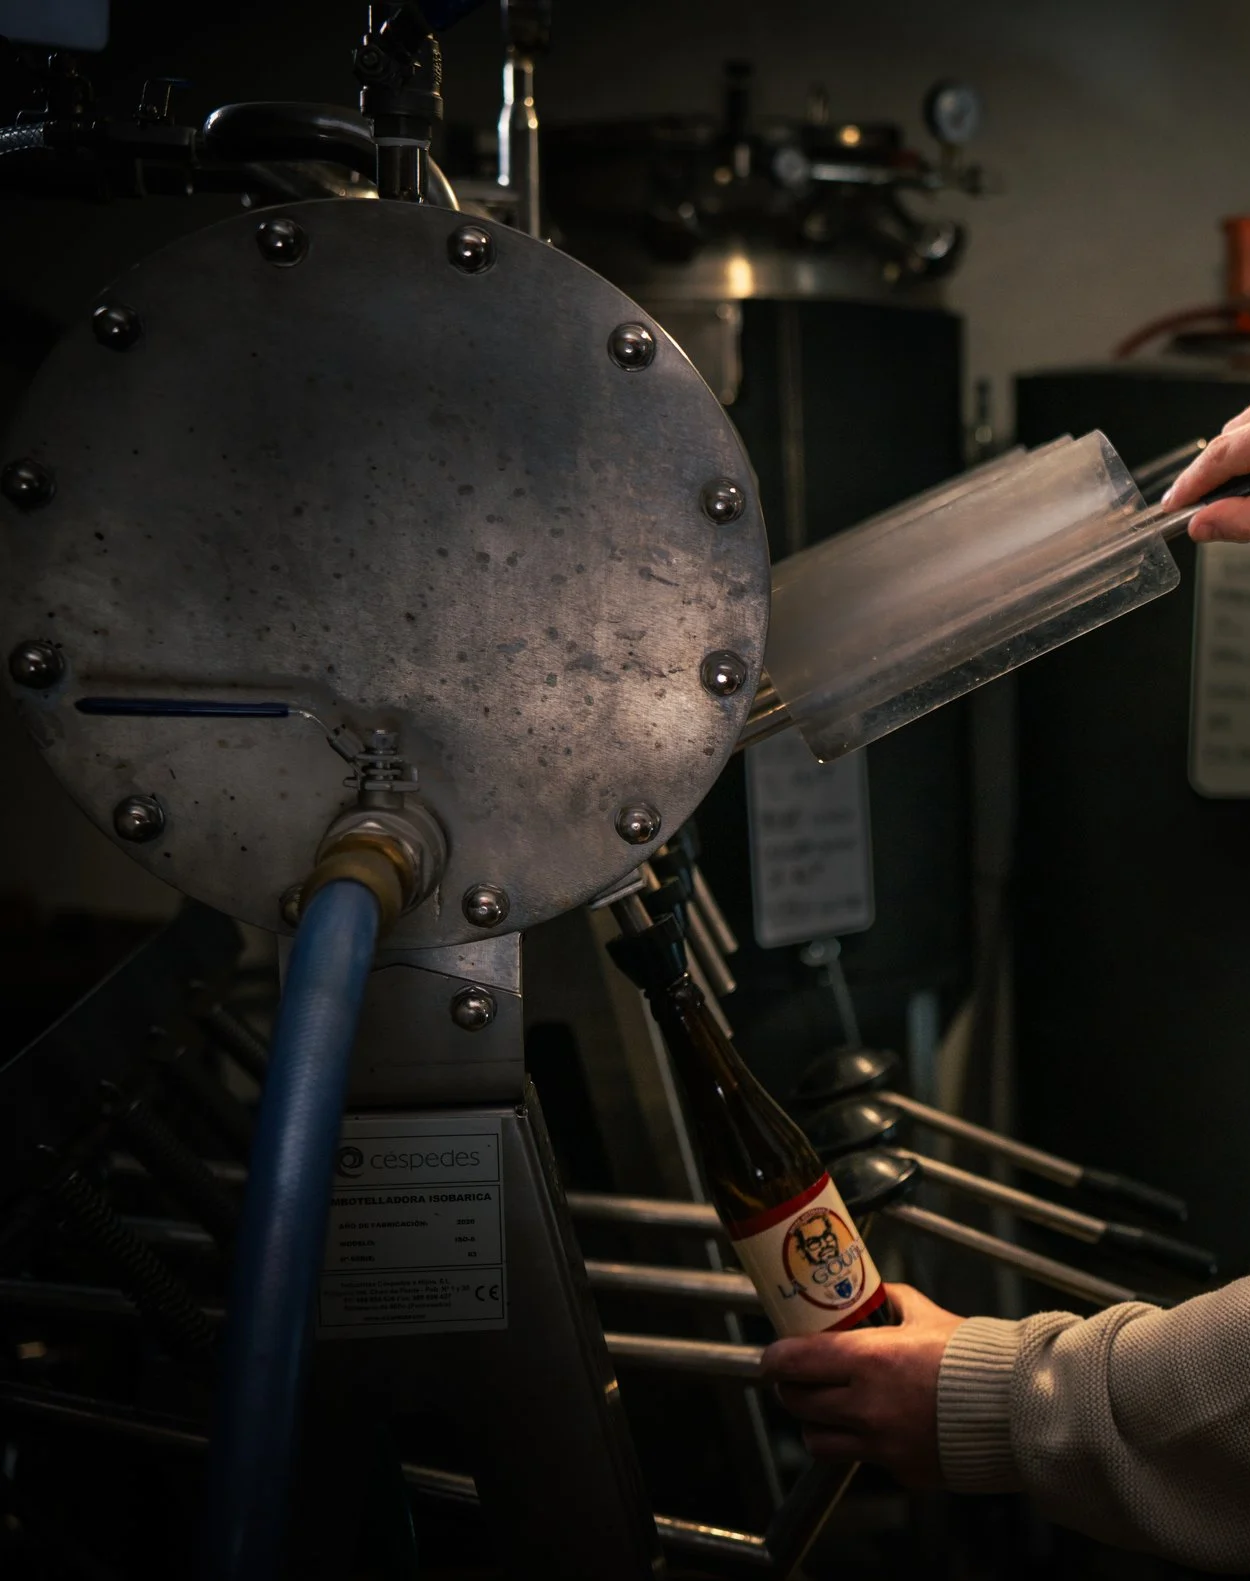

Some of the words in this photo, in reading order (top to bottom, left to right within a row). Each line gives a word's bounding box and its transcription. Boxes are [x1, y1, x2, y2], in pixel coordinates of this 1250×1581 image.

[370, 1149, 480, 1172] céspedes
[330, 1194, 426, 1207] MBOTELLADORA
[429, 1192, 492, 1203] ISOBARICA
